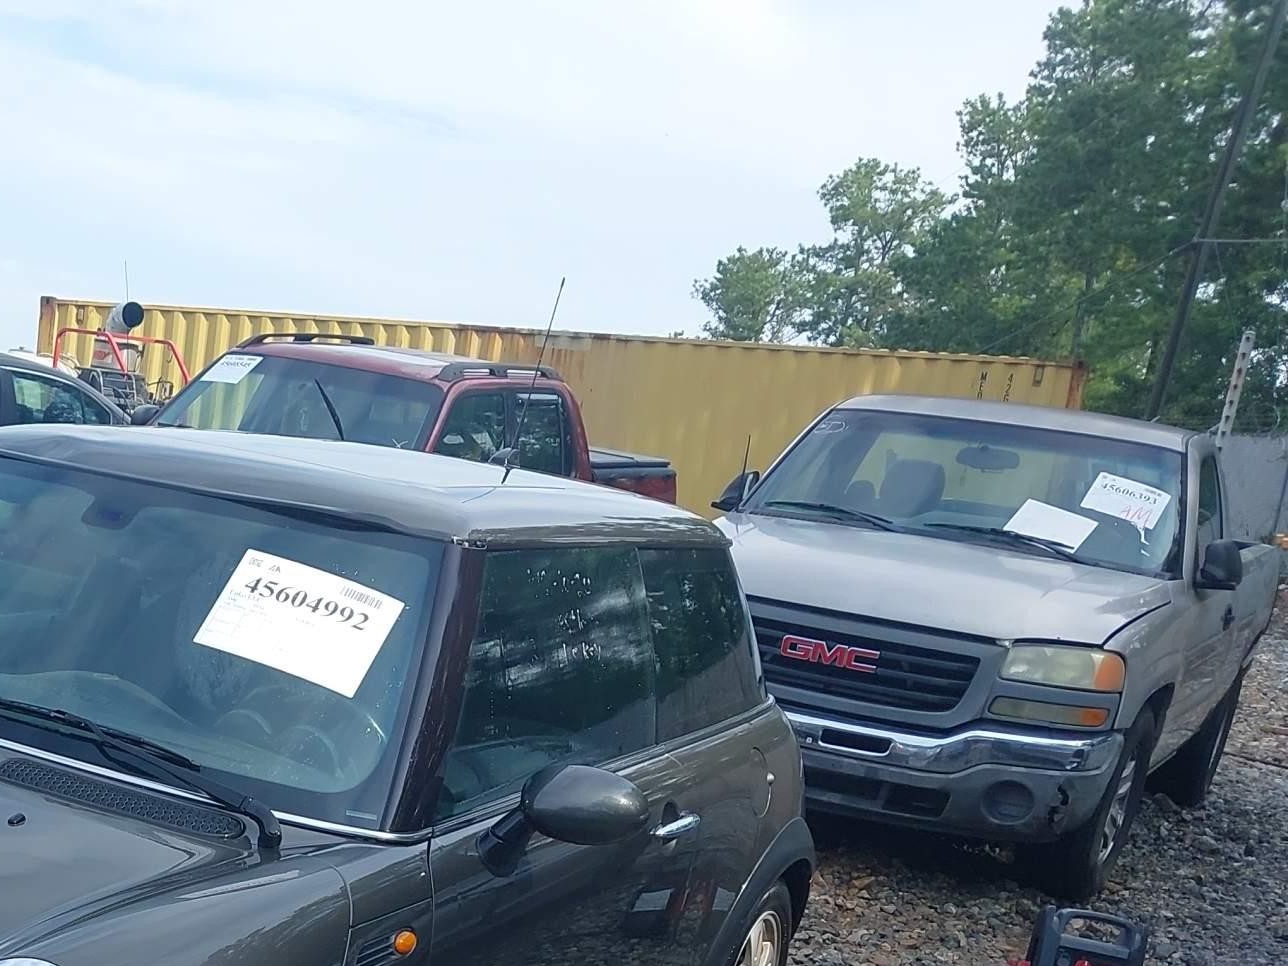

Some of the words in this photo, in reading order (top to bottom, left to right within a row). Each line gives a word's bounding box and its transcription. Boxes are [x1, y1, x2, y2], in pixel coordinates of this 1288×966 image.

[1101, 481, 1158, 505] 45606393
[245, 577, 369, 630] 45604992
[780, 634, 881, 673] GMC
